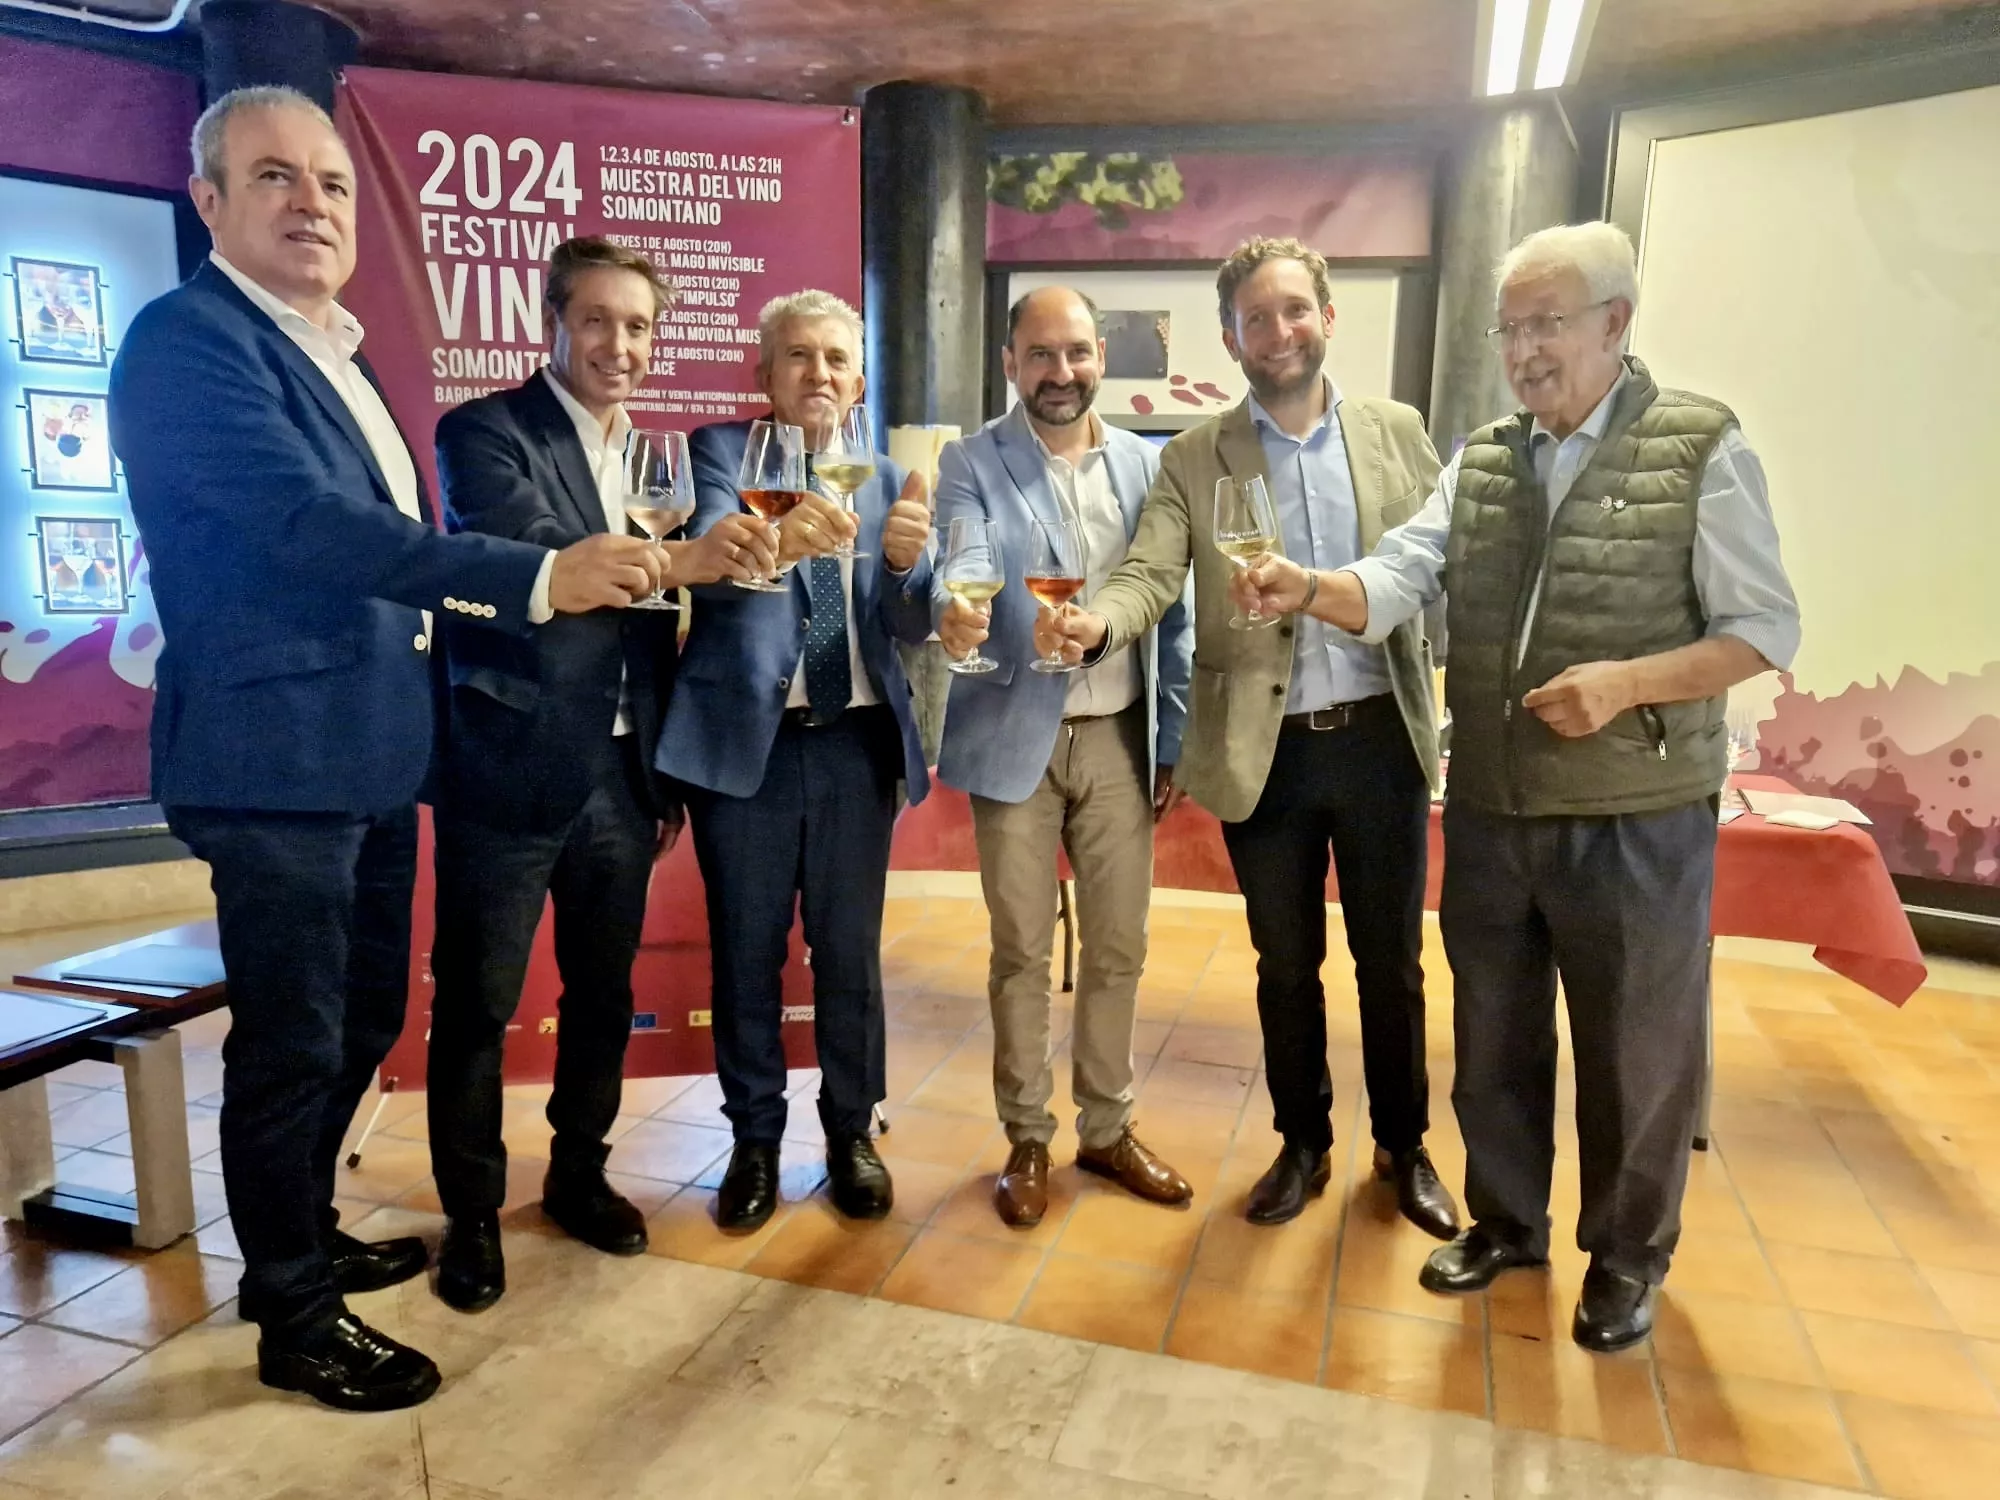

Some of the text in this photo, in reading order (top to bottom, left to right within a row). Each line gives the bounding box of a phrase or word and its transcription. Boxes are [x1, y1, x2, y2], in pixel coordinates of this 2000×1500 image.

[600, 146, 782, 174] 1.2.3.4 DE AGOSTO, A LAS 21H
[418, 130, 582, 215] 2024
[601, 167, 782, 202] MUESTRA DEL VINO
[602, 195, 722, 226] SOMONTANO
[643, 237, 648, 248] 1
[650, 237, 661, 250] DE
[664, 238, 702, 252] AGOSTO
[703, 240, 732, 254] (20H)
[670, 254, 706, 270] MAGO
[708, 256, 764, 273] INVISIBLE
[672, 274, 710, 289] AGOSTO
[712, 276, 740, 290] (20H)
[425, 261, 543, 344] VIN
[671, 312, 708, 324] AGOSTO
[710, 313, 738, 328] (20H)
[660, 326, 684, 341] UNA
[688, 326, 734, 343] MOVIDA
[736, 329, 761, 344] MUS
[654, 346, 661, 358] 4
[664, 347, 676, 360] DE
[677, 348, 714, 361] AGOSTO
[716, 350, 744, 364] (20H)
[647, 361, 676, 376] LACE
[668, 390, 692, 400] VENTA
[622, 401, 682, 413] OMONTANO.COM
